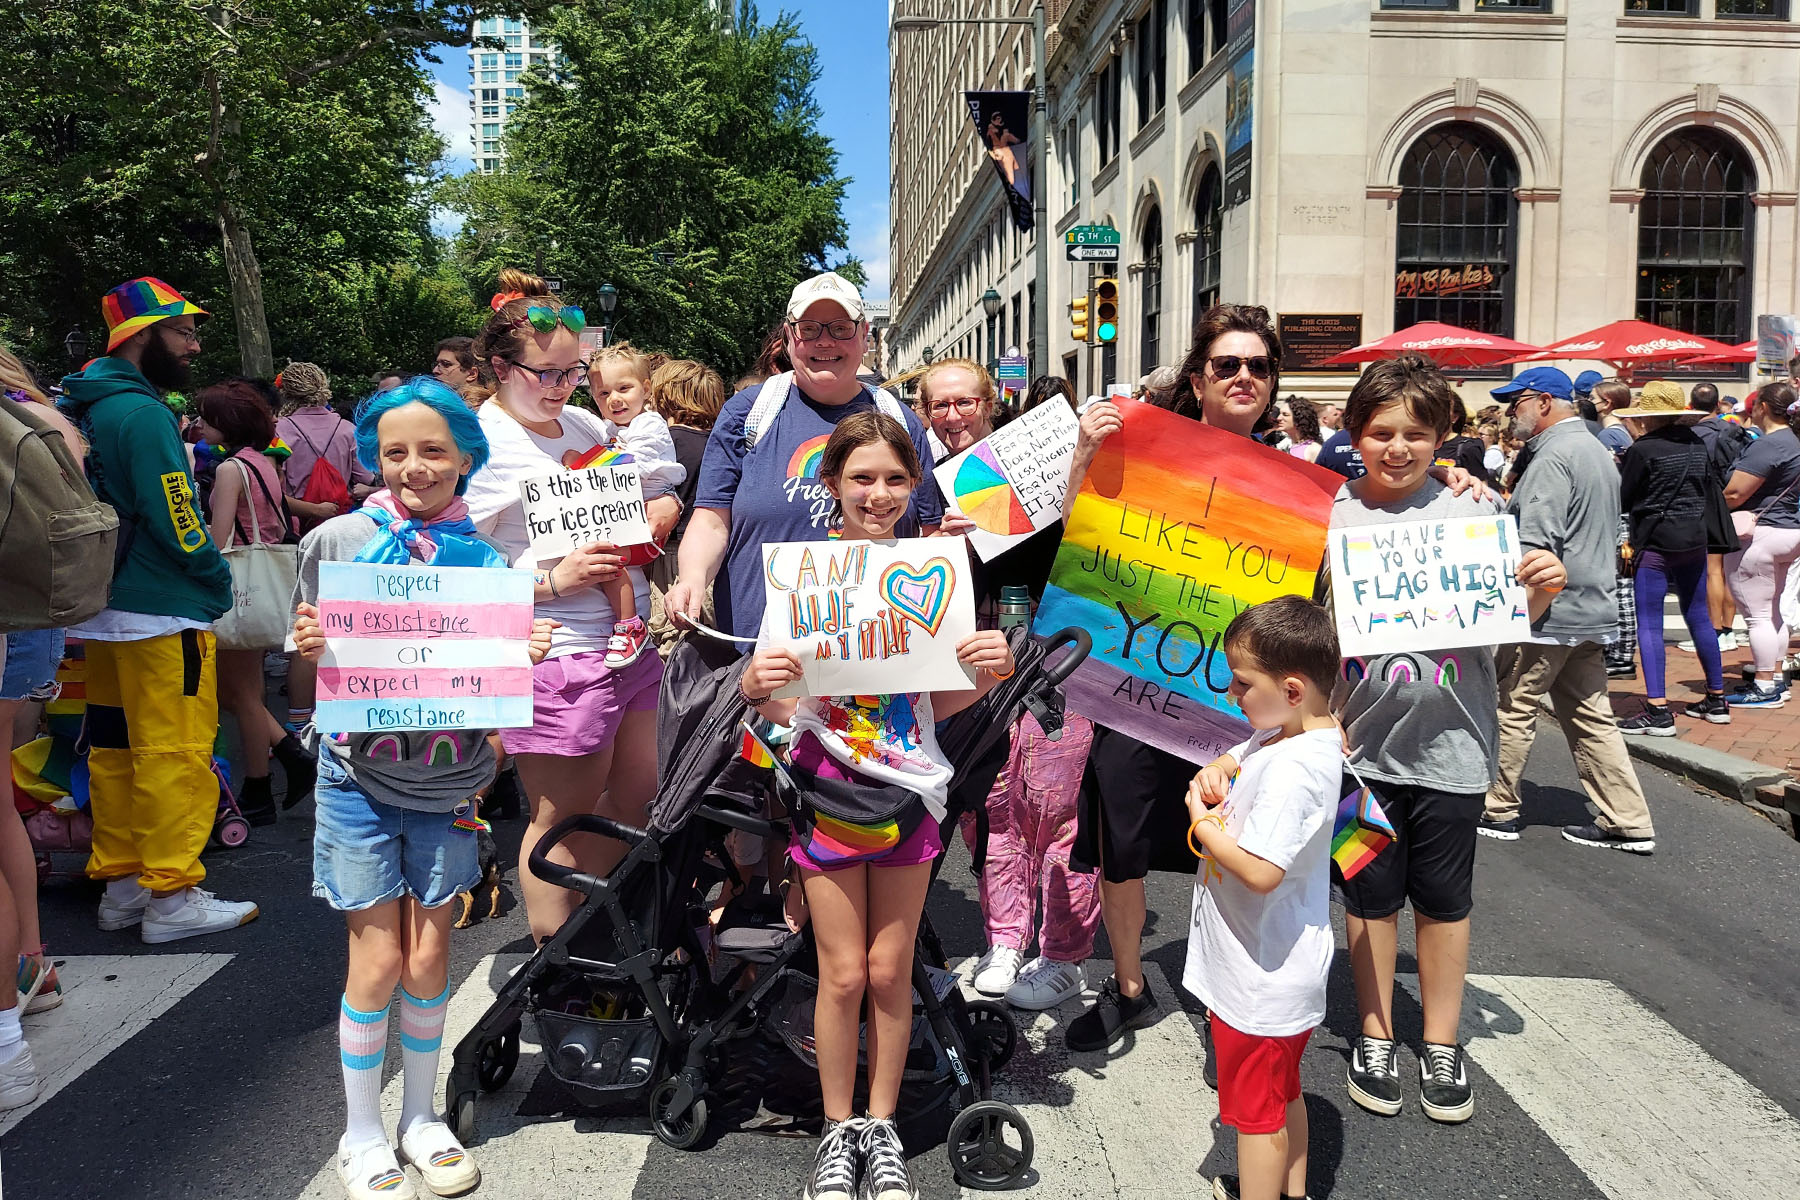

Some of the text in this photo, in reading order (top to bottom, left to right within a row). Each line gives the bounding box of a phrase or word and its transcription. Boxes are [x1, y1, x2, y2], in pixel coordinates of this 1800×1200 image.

[995, 441, 1018, 457] FOR
[1001, 421, 1079, 471] DOES NOT MEAN
[1009, 441, 1076, 484] LESS RIGHTS
[167, 476, 191, 530] FRAGILE
[525, 468, 637, 503] is this the line
[1016, 478, 1041, 498] FOR
[1023, 490, 1056, 518] IT'S
[1204, 476, 1218, 518] I
[528, 500, 646, 540] for ice cream
[1373, 523, 1445, 549] WAVE
[1119, 502, 1291, 585] LIKE YOU
[1380, 545, 1443, 573] YOUR
[376, 573, 441, 600] respect
[1081, 545, 1166, 595] JUST
[1176, 572, 1222, 618] THE
[1352, 558, 1520, 606] FLAG HIGH
[326, 609, 470, 633] my exsistence
[398, 647, 433, 664] or
[1116, 600, 1230, 693] YOU
[347, 674, 482, 698] expect my
[1113, 675, 1189, 721] ARE
[367, 703, 465, 728] resistance
[945, 1046, 970, 1086] ZOE
